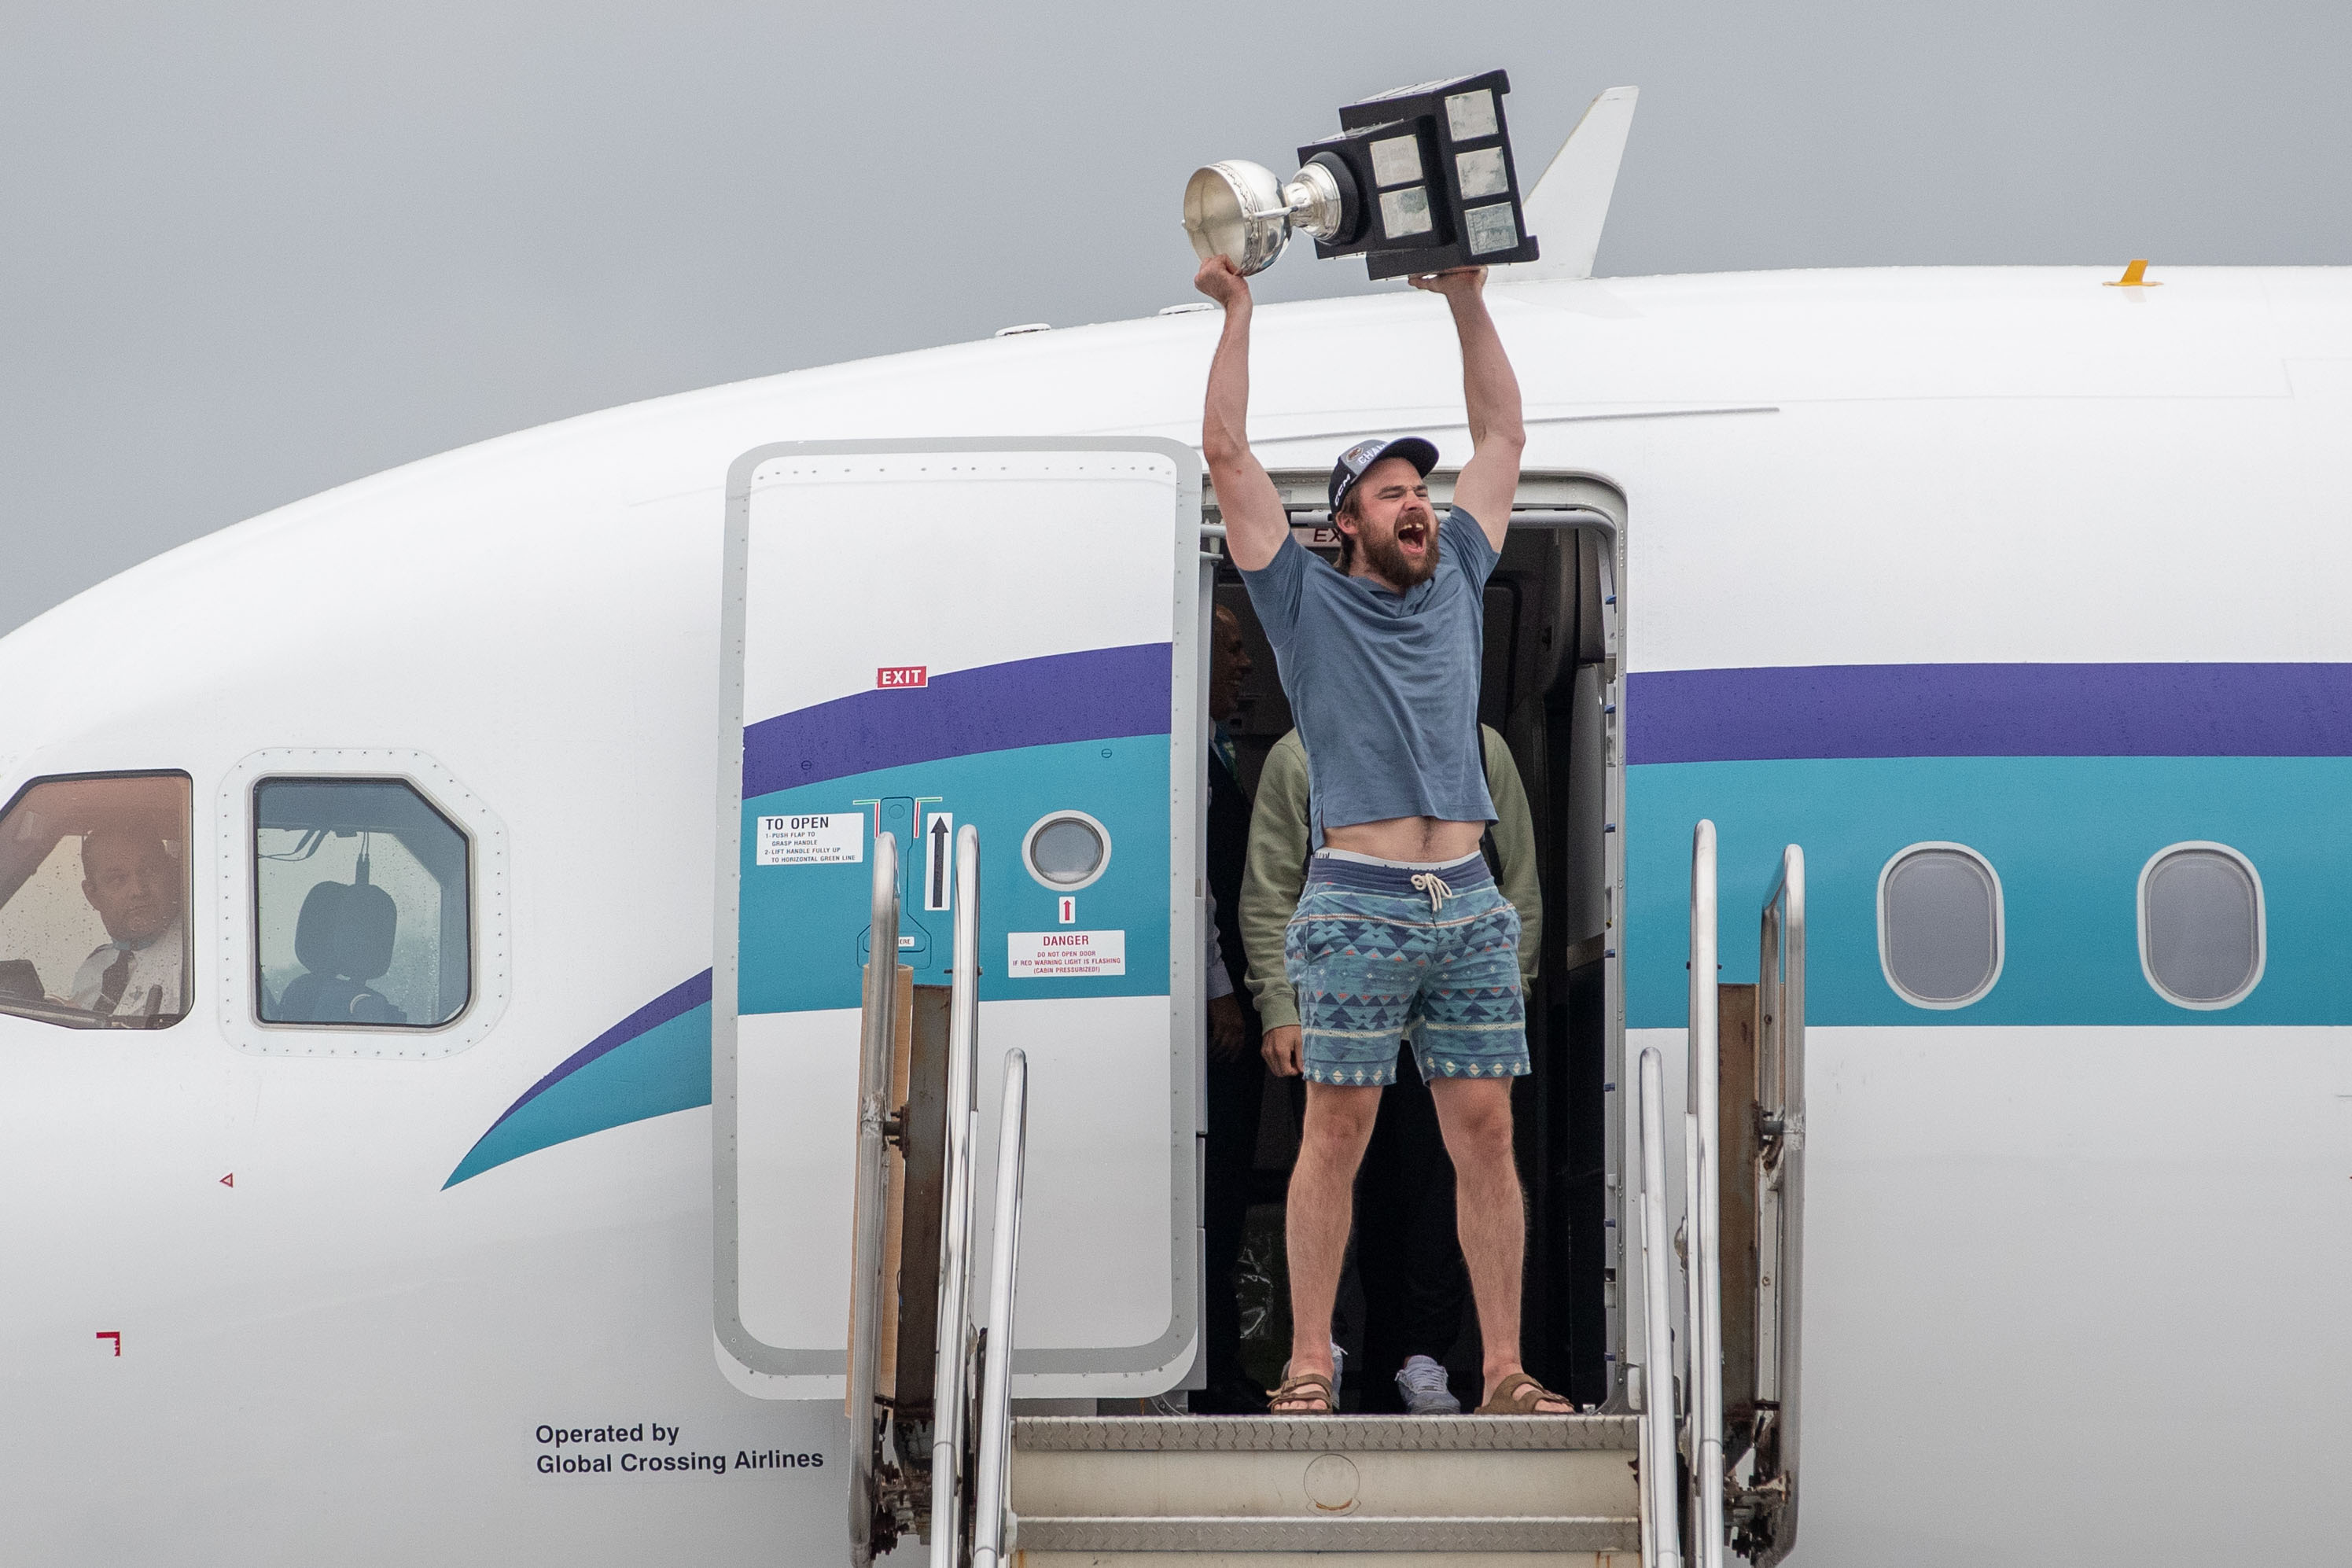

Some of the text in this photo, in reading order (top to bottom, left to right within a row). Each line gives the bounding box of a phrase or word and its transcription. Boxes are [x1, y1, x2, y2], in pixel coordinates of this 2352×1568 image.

[1334, 473, 1351, 506] CCM
[882, 670, 922, 685] EXIT
[766, 816, 829, 830] TO OPEN
[1043, 935, 1089, 946] DANGER
[536, 1423, 679, 1448] Operated by
[536, 1449, 824, 1474] Global Crossing Airlines
